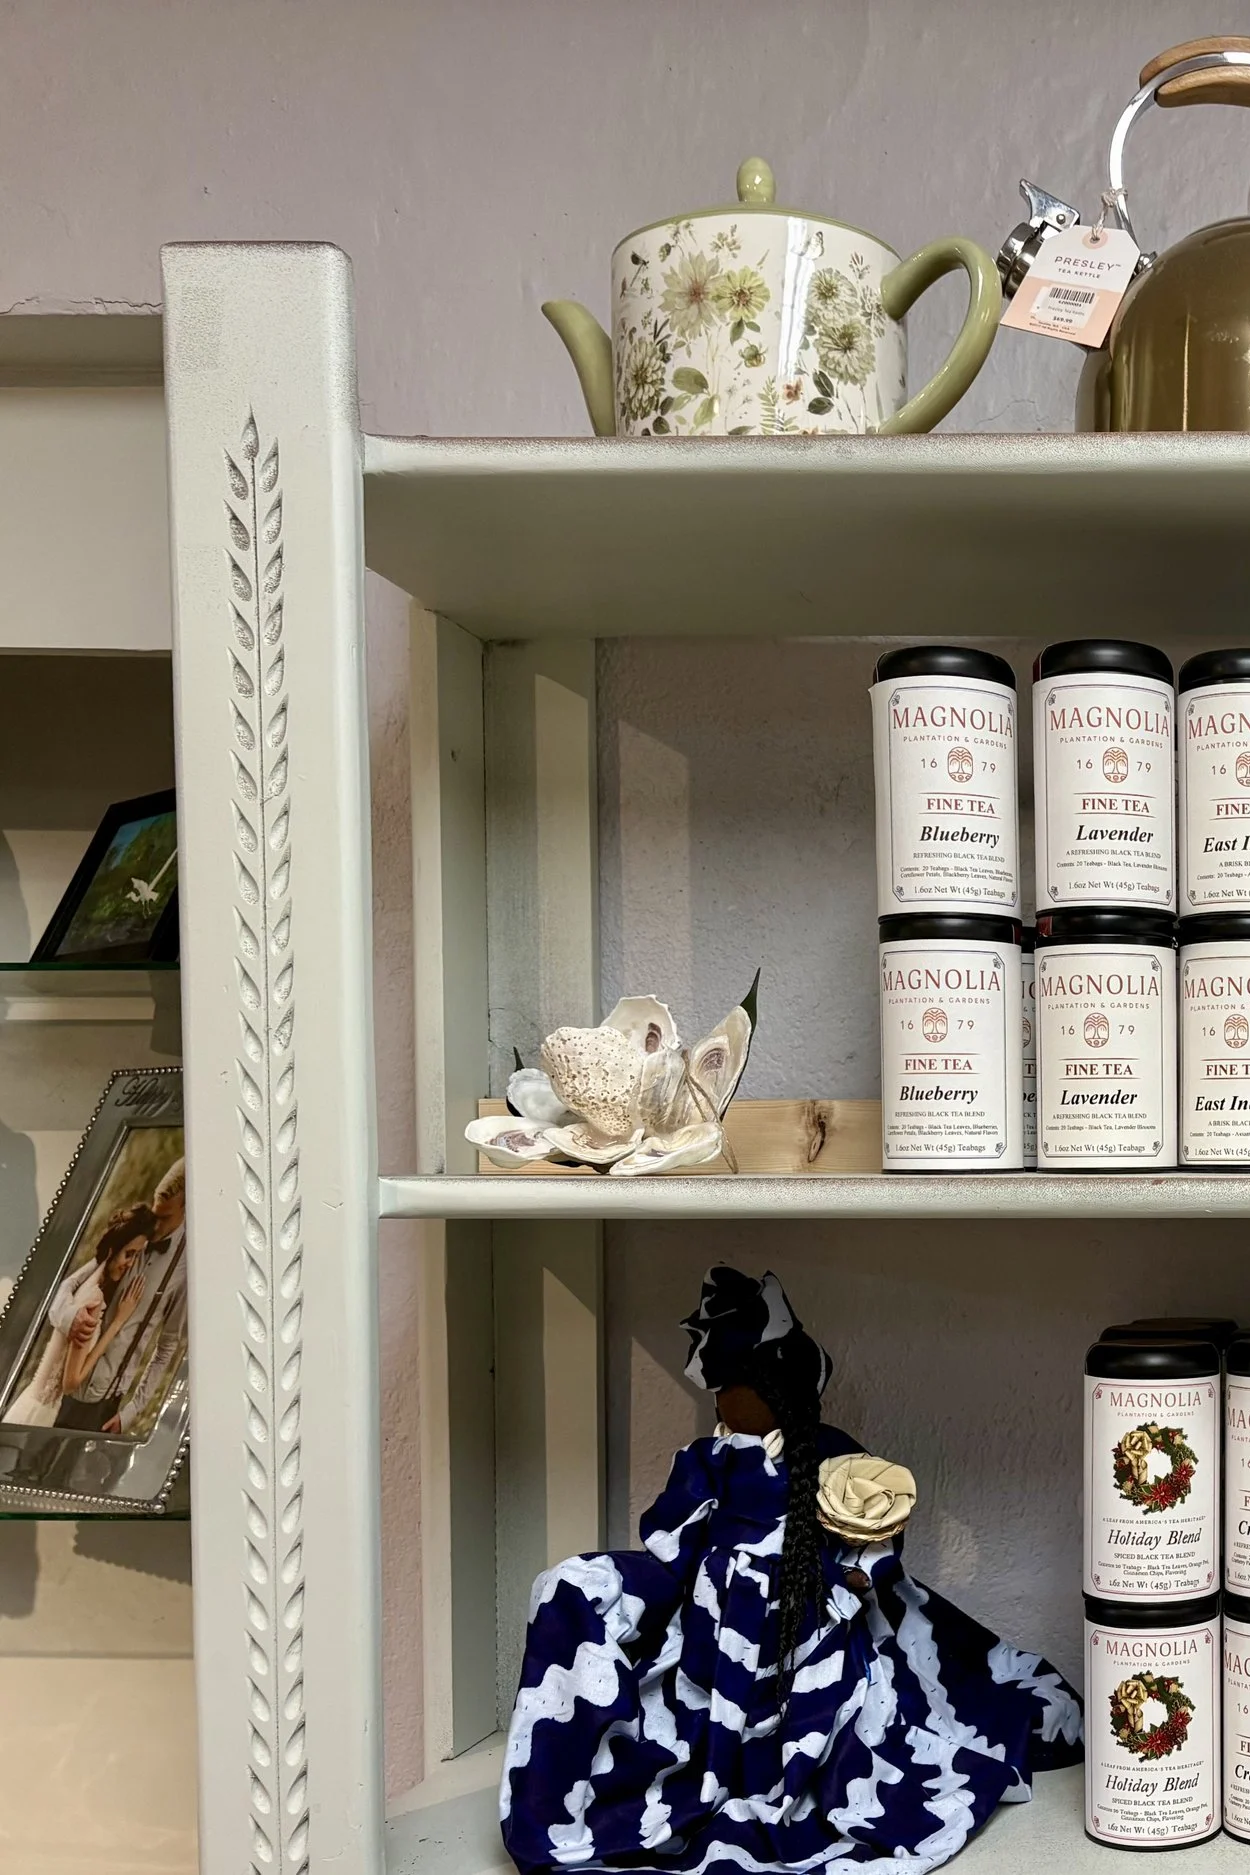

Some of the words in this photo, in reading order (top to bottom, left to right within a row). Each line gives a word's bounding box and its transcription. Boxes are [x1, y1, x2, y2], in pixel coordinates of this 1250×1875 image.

[1075, 271, 1101, 279] KETTLE
[893, 706, 1013, 738] MAGNOLIA
[1050, 706, 1170, 737] MAGNOLIA
[927, 798, 963, 811] FINE
[969, 801, 995, 814] TEA
[1082, 798, 1118, 811] FINE
[1122, 800, 1150, 813] TEA
[1216, 804, 1250, 816] FINE
[920, 826, 1000, 848] Blueberry
[1076, 825, 1153, 843] Lavender
[1203, 837, 1237, 853] East
[1103, 881, 1114, 889] Wt
[1116, 881, 1135, 891] (45g)
[1137, 882, 1160, 892] Teabags
[883, 969, 1001, 991] MAGNOLIA
[1041, 974, 1159, 997] MAGNOLIA
[905, 1059, 937, 1070] FINE
[942, 1059, 973, 1070] TEA
[1065, 1064, 1098, 1075] FINE
[1103, 1064, 1133, 1075] TEA
[1206, 1065, 1238, 1076] FINE
[899, 1086, 978, 1103] Blueberry
[1061, 1090, 1137, 1106] Lavender
[1195, 1096, 1226, 1111] East
[1110, 1391, 1202, 1407] MAGNOLIA
[1107, 1529, 1162, 1550] Holiday
[1166, 1528, 1201, 1545] Blend
[1176, 1551, 1196, 1559] BLEND
[1106, 1639, 1198, 1657] MAGNOLIA
[1105, 1774, 1158, 1798] Holiday
[1163, 1773, 1200, 1792] Blend
